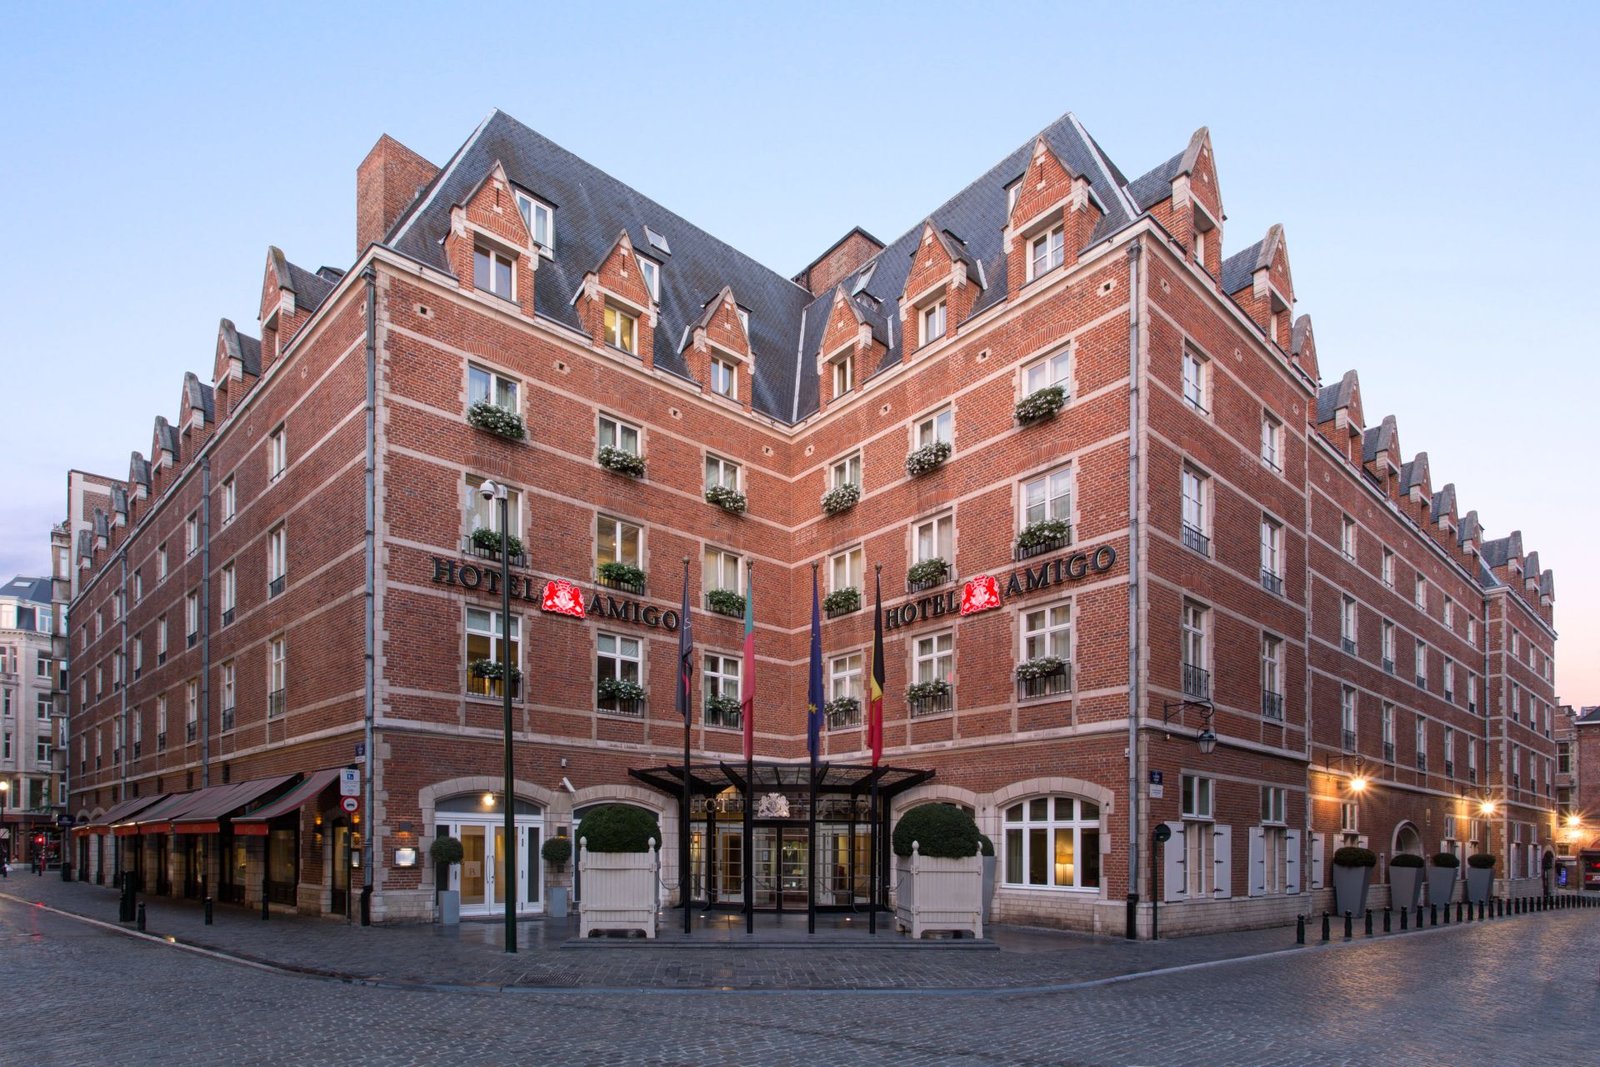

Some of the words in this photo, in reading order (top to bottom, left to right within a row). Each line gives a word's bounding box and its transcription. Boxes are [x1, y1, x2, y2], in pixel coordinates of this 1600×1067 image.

[432, 556, 538, 602] HOTEL
[586, 594, 679, 631] AMIGO
[885, 591, 960, 631] HOTEL
[1004, 544, 1116, 597] AMIGO
